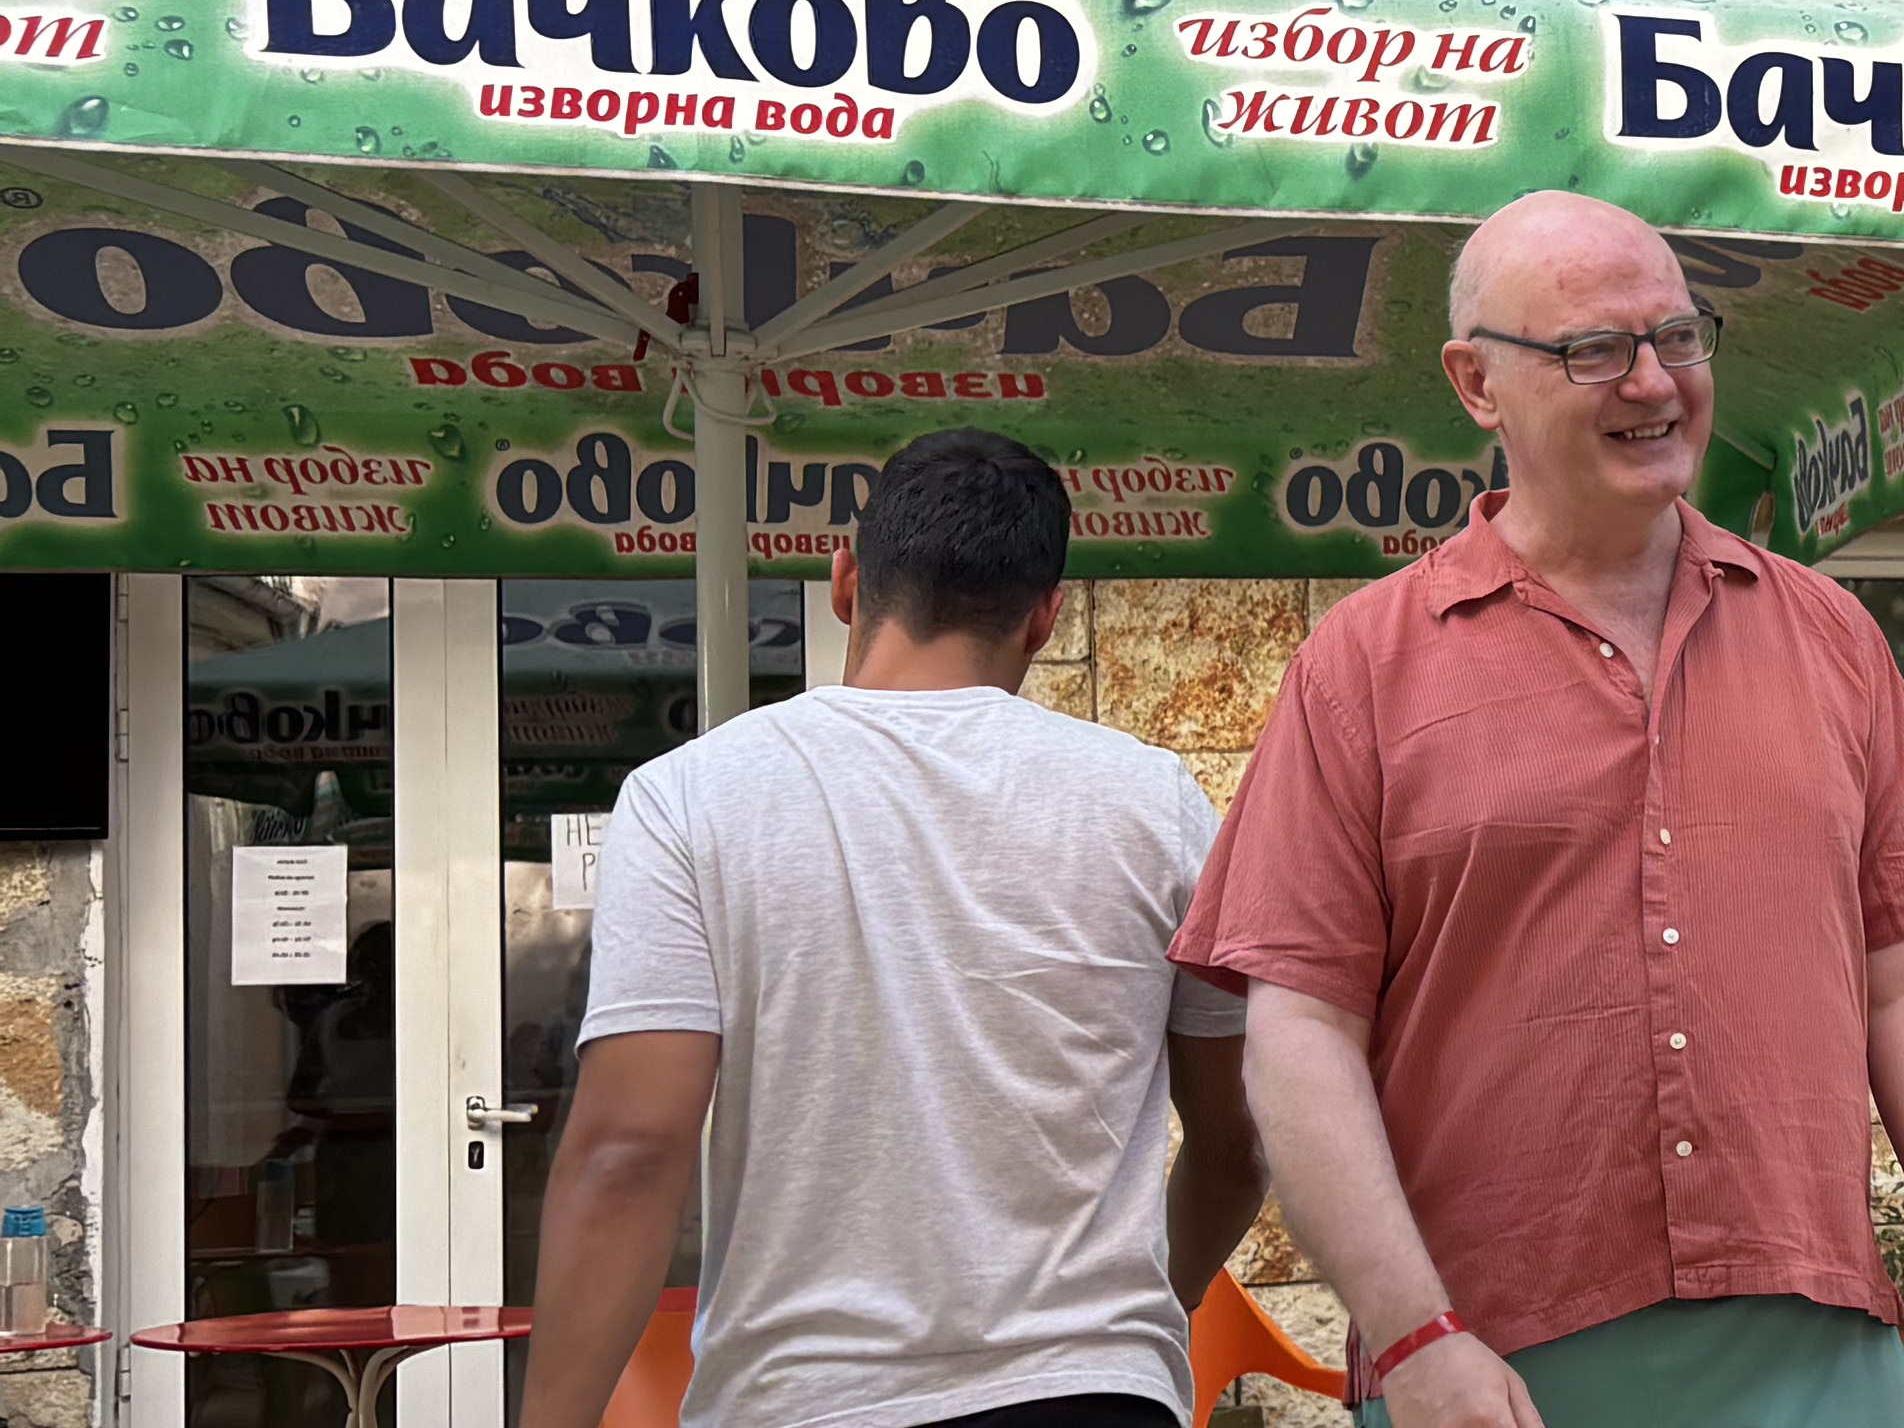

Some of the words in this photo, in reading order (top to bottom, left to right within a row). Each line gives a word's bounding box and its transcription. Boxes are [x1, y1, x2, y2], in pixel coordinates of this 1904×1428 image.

[1178, 7, 1416, 83] избор
[1431, 33, 1529, 74] на
[479, 82, 735, 134] изворна
[756, 92, 896, 141] вода
[1216, 88, 1499, 145] живот
